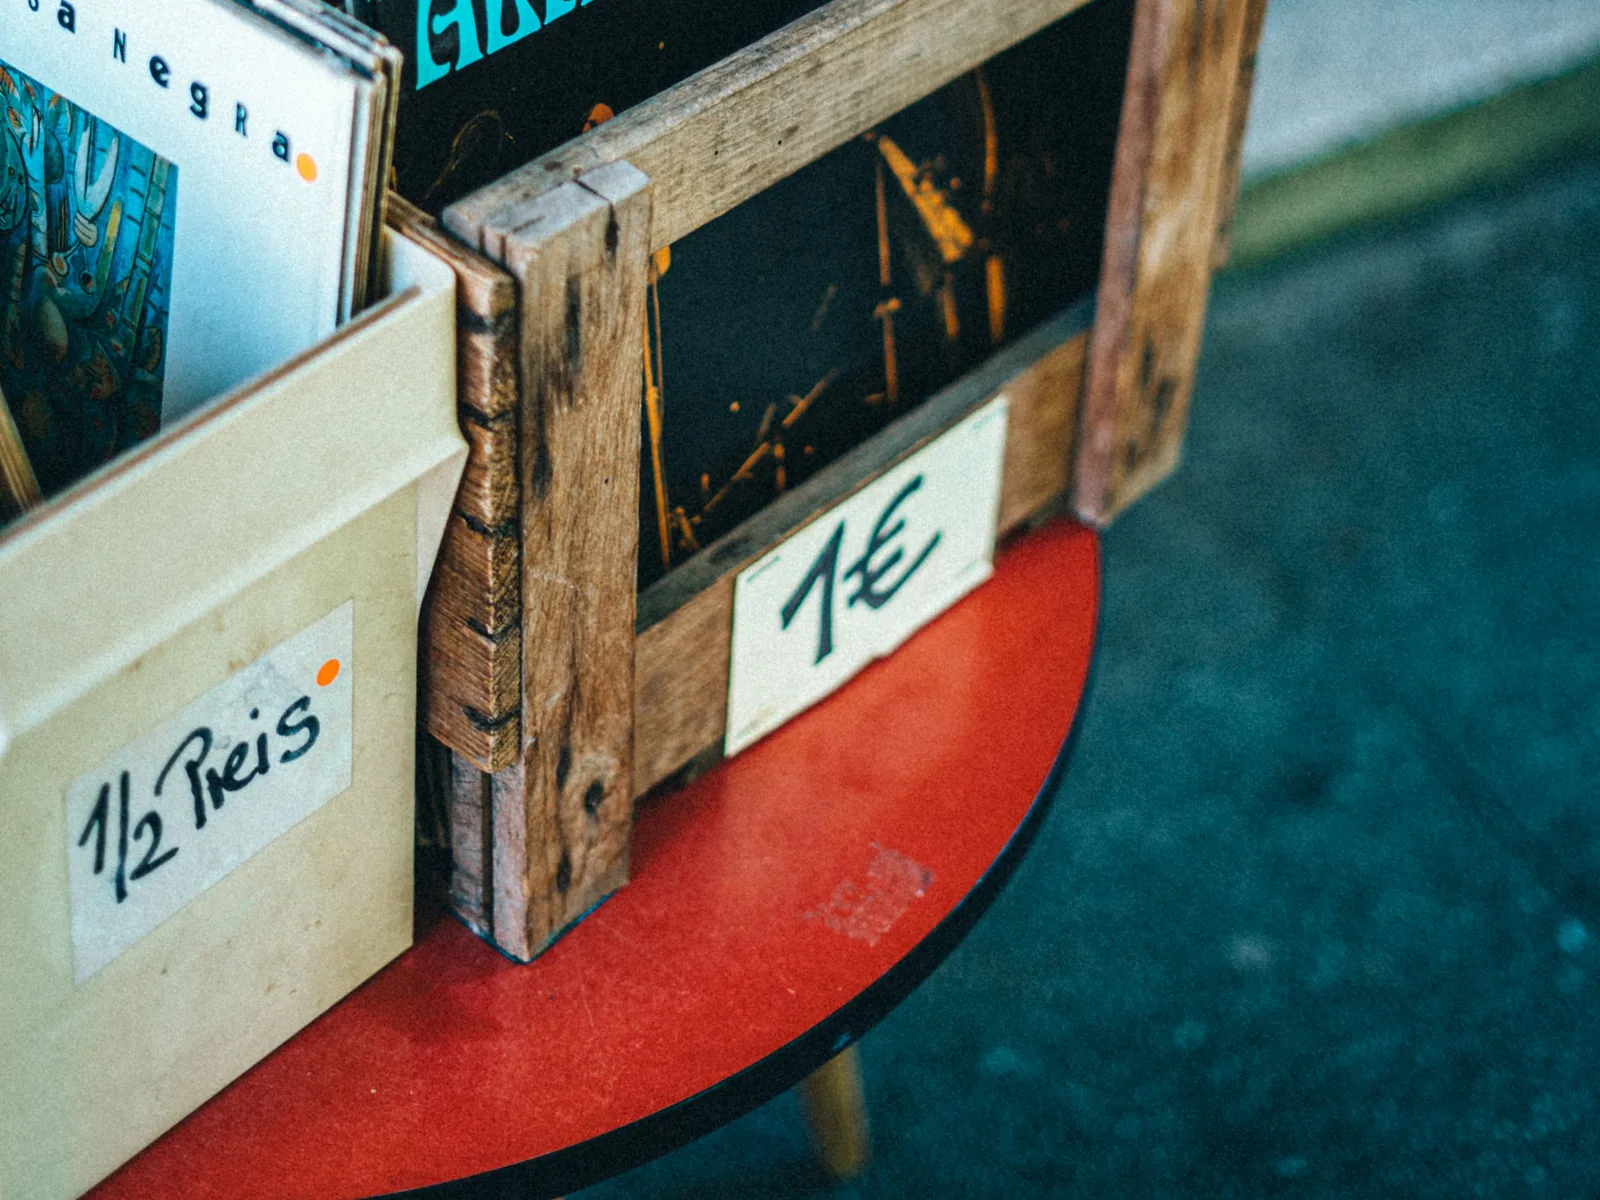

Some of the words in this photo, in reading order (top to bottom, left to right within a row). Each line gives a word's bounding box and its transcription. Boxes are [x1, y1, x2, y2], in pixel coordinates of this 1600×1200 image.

[781, 473, 943, 667] 1€
[78, 769, 180, 904] 1/2
[155, 696, 321, 830] Preis
